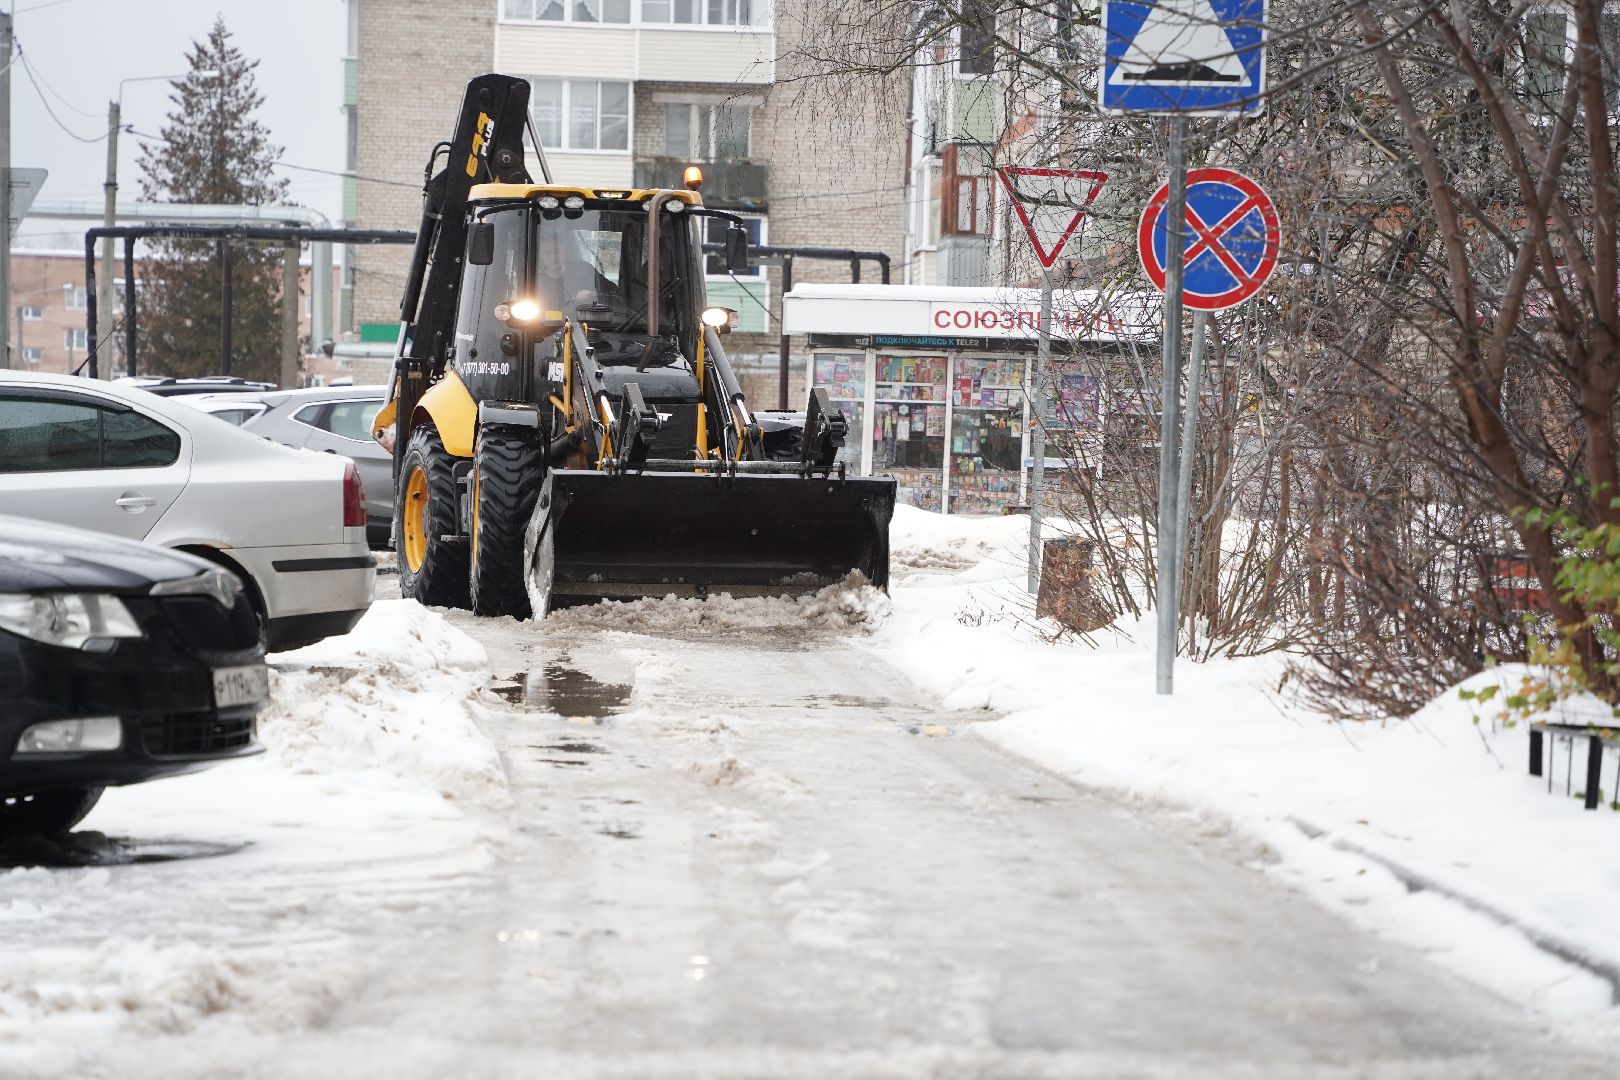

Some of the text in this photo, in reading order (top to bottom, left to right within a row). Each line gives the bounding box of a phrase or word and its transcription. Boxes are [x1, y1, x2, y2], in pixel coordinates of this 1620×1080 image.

[480, 118, 495, 157] PLUS
[934, 309, 1123, 332] СОЮЗПЧАТЬ
[875, 335, 948, 346] ПОДКЛЮЧАЙТЕСЬ
[955, 338, 979, 347] TELE2
